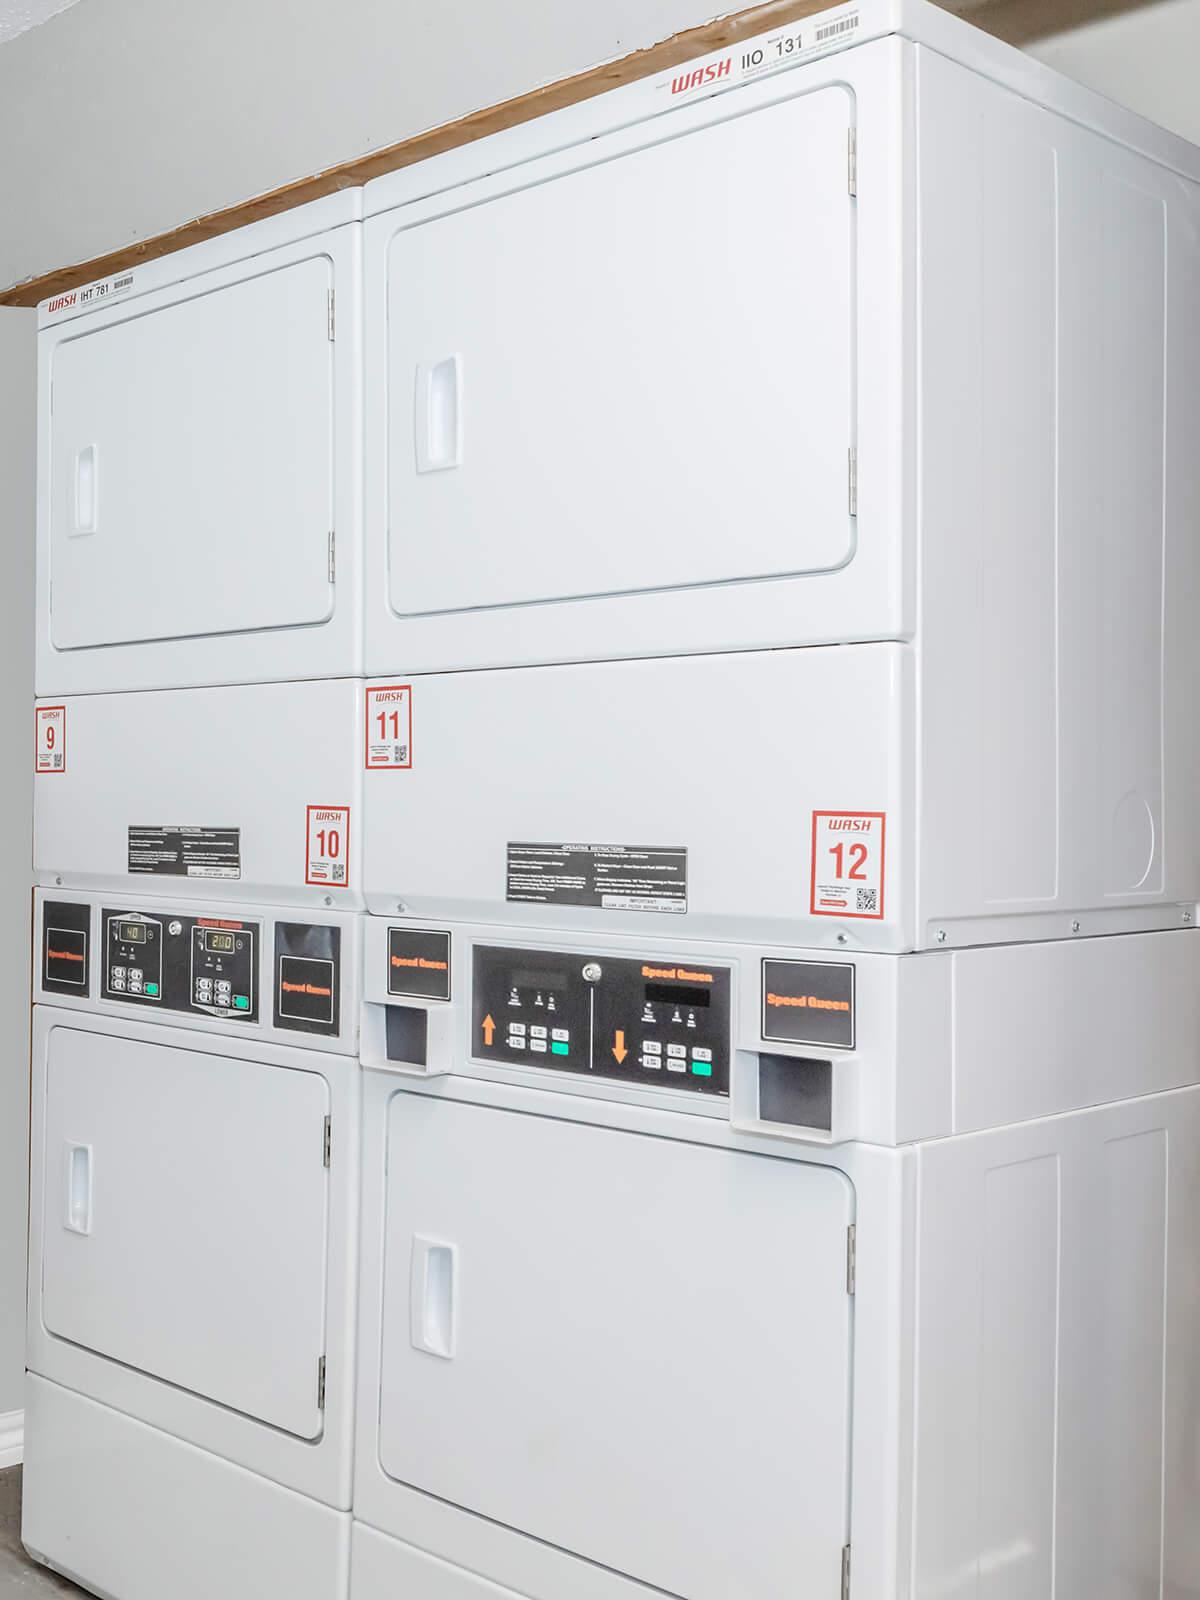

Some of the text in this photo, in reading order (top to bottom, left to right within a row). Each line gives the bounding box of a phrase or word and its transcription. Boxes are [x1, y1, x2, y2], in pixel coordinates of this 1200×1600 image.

[671, 58, 731, 94] WASH
[776, 34, 802, 56] 131
[48, 293, 77, 312] WASH
[80, 289, 94, 302] IHT
[96, 284, 109, 297] 781
[375, 692, 403, 702] WASH
[376, 710, 398, 740] 11
[46, 726, 55, 750] 9
[315, 812, 342, 822] WASH
[828, 819, 871, 831] WASH
[316, 829, 339, 858] 10
[828, 842, 868, 880] 12
[197, 918, 219, 927] Speed
[391, 956, 447, 970] Speed Queen
[642, 966, 714, 982] Speed Queen
[283, 981, 331, 996] Speed Queen
[767, 993, 849, 1011] Speed Queen
